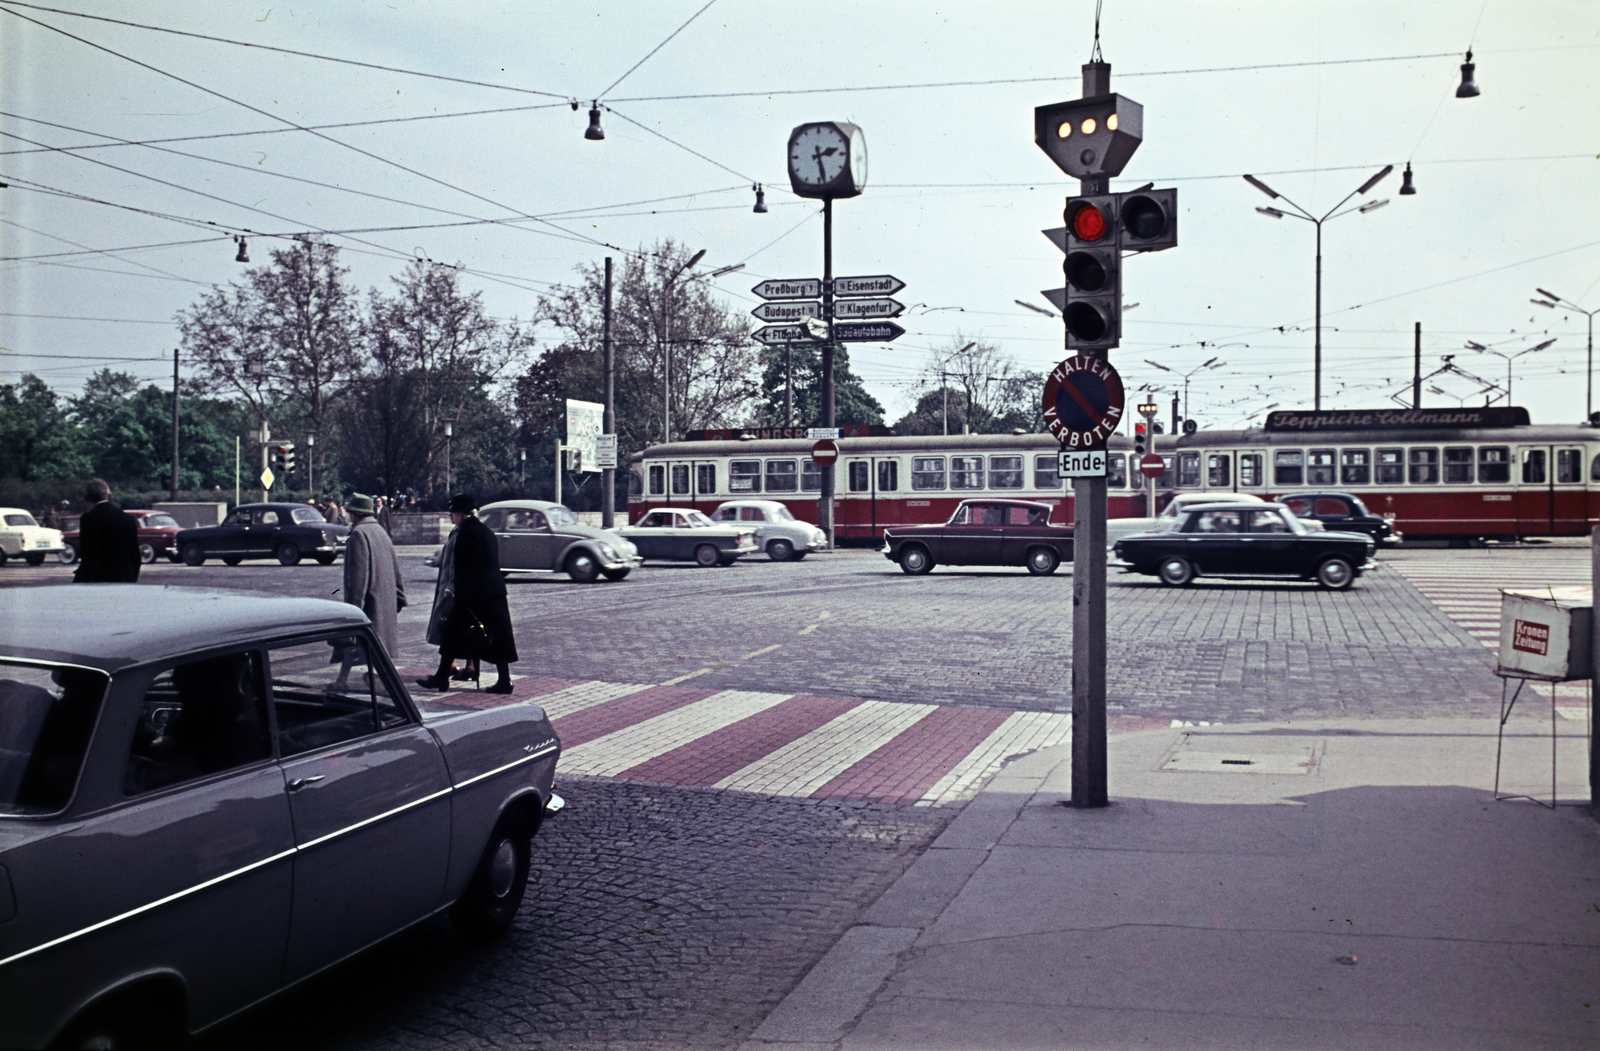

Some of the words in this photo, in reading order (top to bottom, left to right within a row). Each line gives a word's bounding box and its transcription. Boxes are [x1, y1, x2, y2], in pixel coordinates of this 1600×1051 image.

[765, 283, 806, 296] Preßburg
[847, 279, 893, 292] Eisenstadt
[764, 305, 805, 317] Budapest
[839, 305, 846, 313] 17
[847, 302, 893, 316] Klagenfurt
[1052, 356, 1112, 383] HALTEN
[1043, 405, 1122, 446] VERBOTEN
[1063, 454, 1102, 472] Ende
[1516, 621, 1548, 640] Kronen
[1514, 634, 1547, 654] Zeitung
